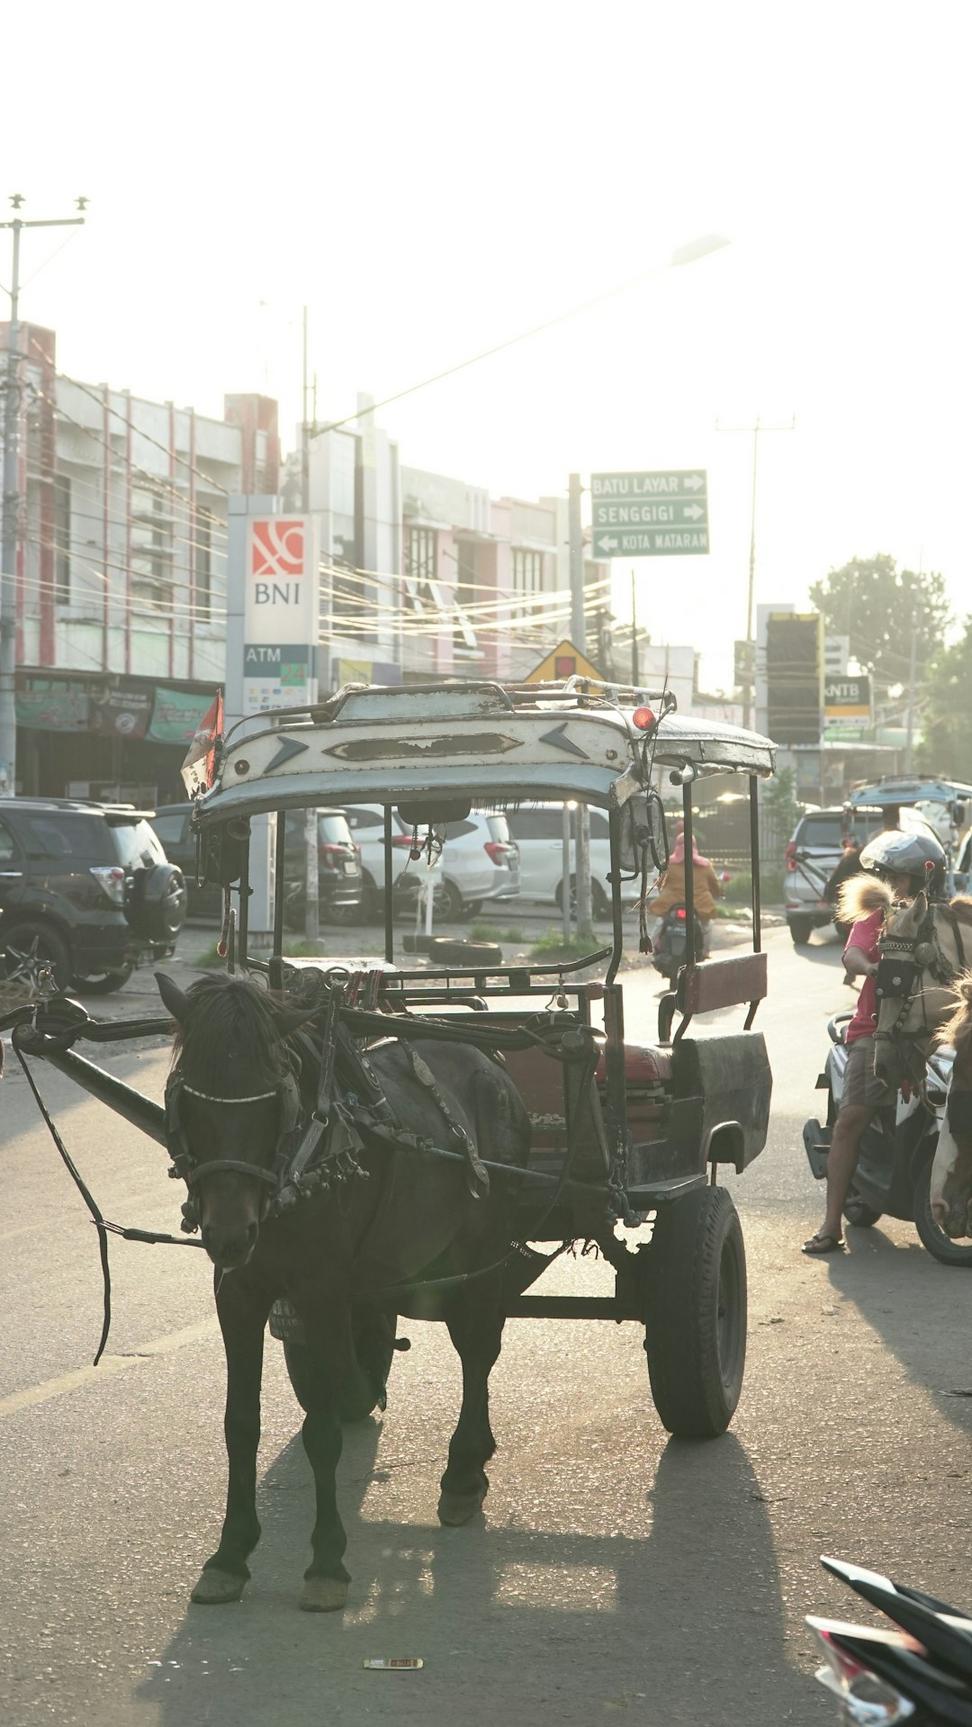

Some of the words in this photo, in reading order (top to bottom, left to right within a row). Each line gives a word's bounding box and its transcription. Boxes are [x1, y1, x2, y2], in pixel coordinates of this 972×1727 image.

[593, 479, 629, 494] BATU
[633, 477, 679, 493] LAYAR
[598, 505, 674, 523] SENGGIGI
[622, 534, 650, 550] KOTA
[254, 583, 300, 604] BNI
[246, 647, 281, 662] ATM
